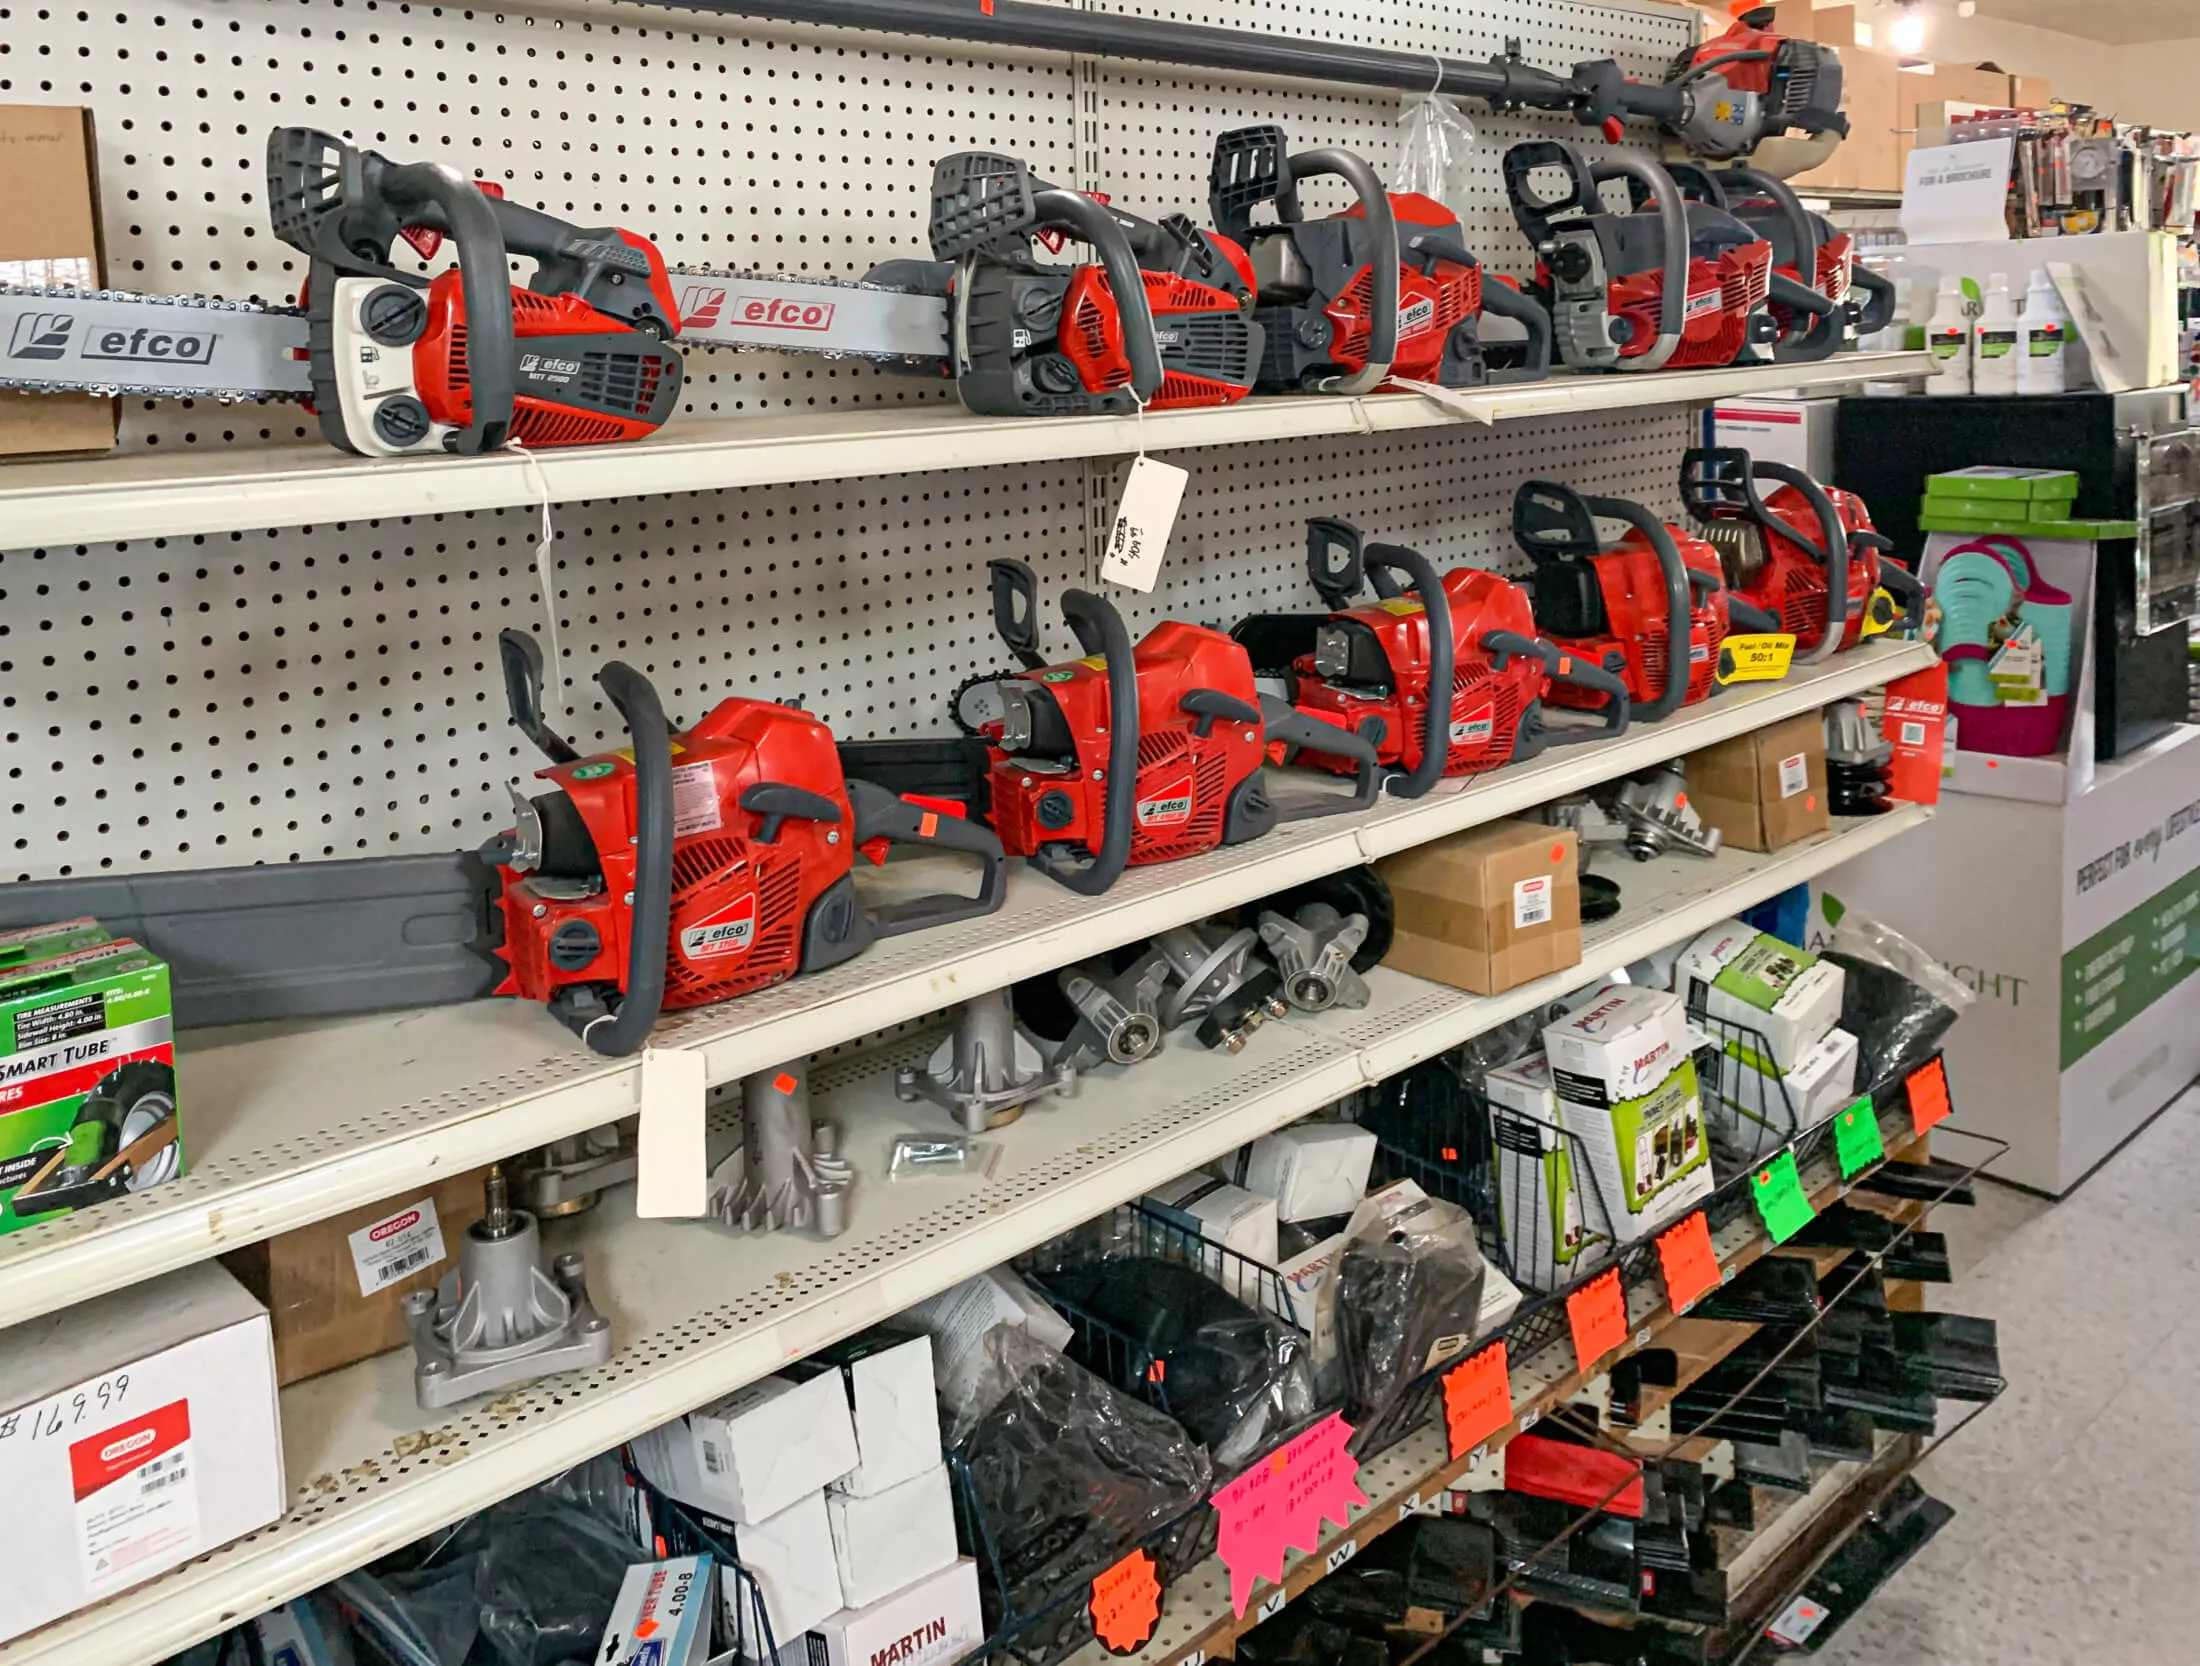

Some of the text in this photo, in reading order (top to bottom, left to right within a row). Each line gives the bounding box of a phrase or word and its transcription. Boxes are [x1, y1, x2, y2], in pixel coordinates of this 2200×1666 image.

[744, 298, 823, 325] efco
[1407, 305, 1428, 321] efco
[101, 329, 202, 358] efco
[543, 358, 575, 372] efco
[1761, 641, 1773, 649] Oil
[1750, 652, 1774, 663] 50:1
[1909, 700, 1941, 713] efco
[1160, 800, 1184, 811] efco
[712, 925, 744, 939] efco
[16, 996, 93, 1020] TIRE MEASUREMENTS
[1571, 998, 1626, 1029] MARTIN
[17, 1025, 49, 1040] Sidewall
[49, 1020, 75, 1033] Height:
[31, 1014, 57, 1027] Width:
[0, 1039, 109, 1081] SMART TUBE
[4, 1156, 37, 1174] INSIDE
[371, 1212, 418, 1240] OREGON
[1329, 1543, 1351, 1568] W
[668, 1572, 693, 1617] 4.00-8
[1264, 1594, 1280, 1613] V
[870, 1616, 947, 1666] MARTIN
